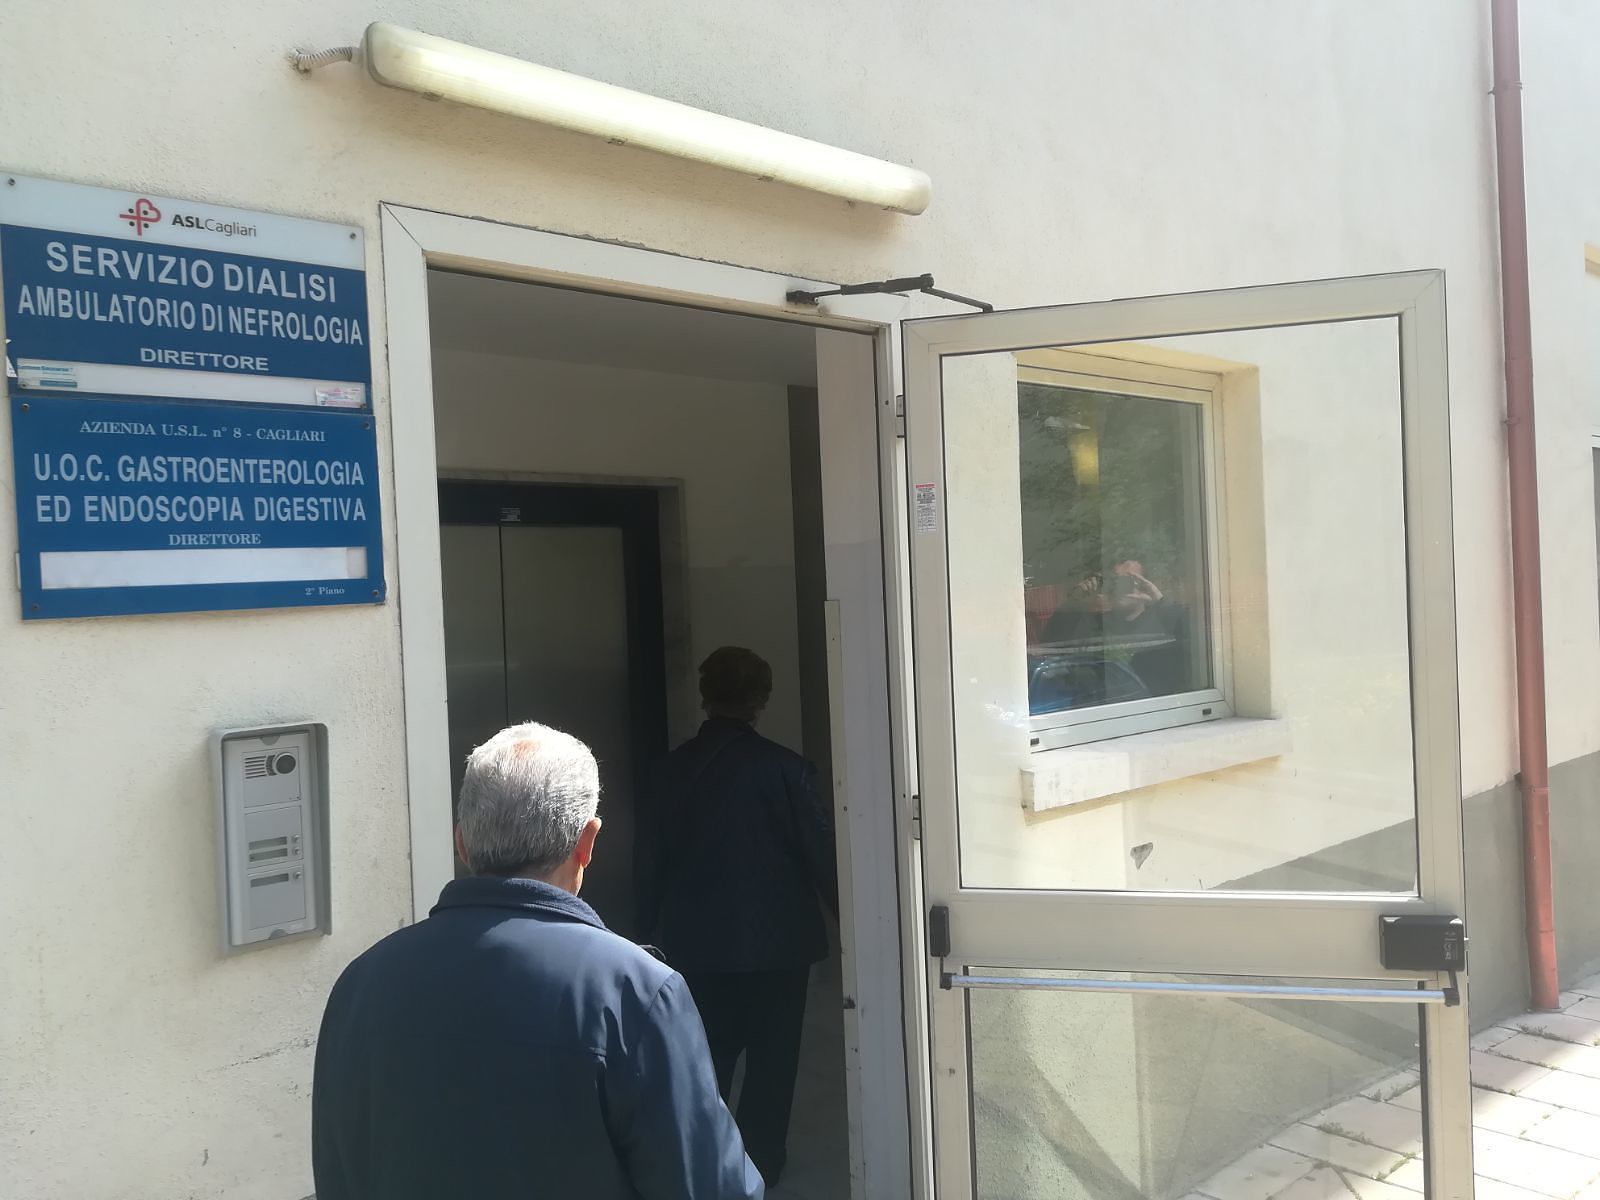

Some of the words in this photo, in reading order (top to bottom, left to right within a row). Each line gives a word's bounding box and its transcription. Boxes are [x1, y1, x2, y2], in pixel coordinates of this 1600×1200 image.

[46, 241, 214, 289] SERVIZIO
[223, 264, 336, 303] DIALISI
[18, 284, 196, 330] AMBULATORIO
[202, 303, 223, 333] DI
[229, 305, 364, 346] NEFROLOGIA
[140, 348, 269, 371] DIRETTORE
[80, 420, 156, 435] AZIENDA
[162, 423, 207, 437] U.S.L.
[213, 426, 227, 438] n°
[233, 427, 242, 439] 8
[256, 427, 326, 442] CAGLIARI
[33, 453, 110, 482] U.O.C.
[118, 454, 365, 486] GASTROENTEROLOGIA
[36, 495, 71, 523] ED
[84, 495, 244, 522] ENDOSCOPIA
[254, 497, 366, 522] DIGESTIVA
[168, 532, 261, 546] DIRETTORE
[319, 586, 345, 596] Piano
